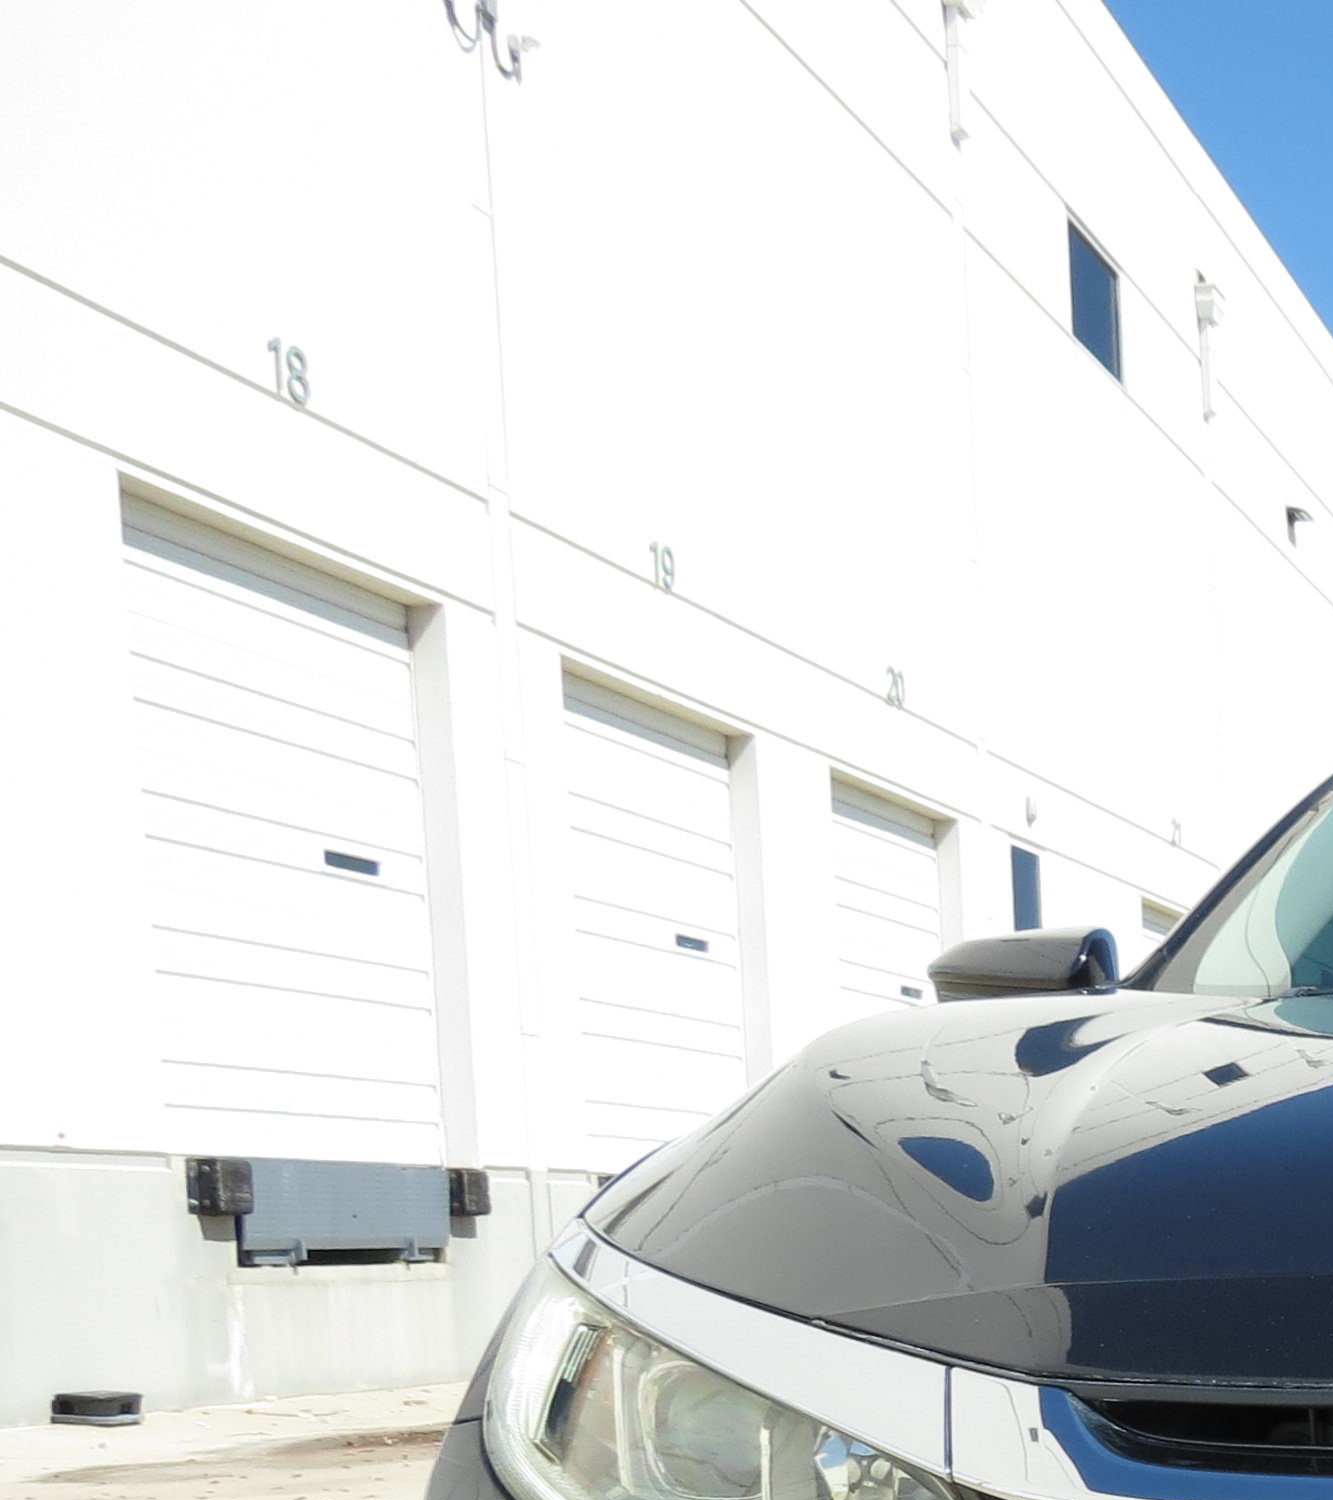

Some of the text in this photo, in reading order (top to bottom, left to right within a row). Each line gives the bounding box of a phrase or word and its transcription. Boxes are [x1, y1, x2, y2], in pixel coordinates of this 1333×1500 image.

[267, 337, 310, 406] 18
[648, 541, 675, 594] 19
[886, 665, 906, 711] 20
